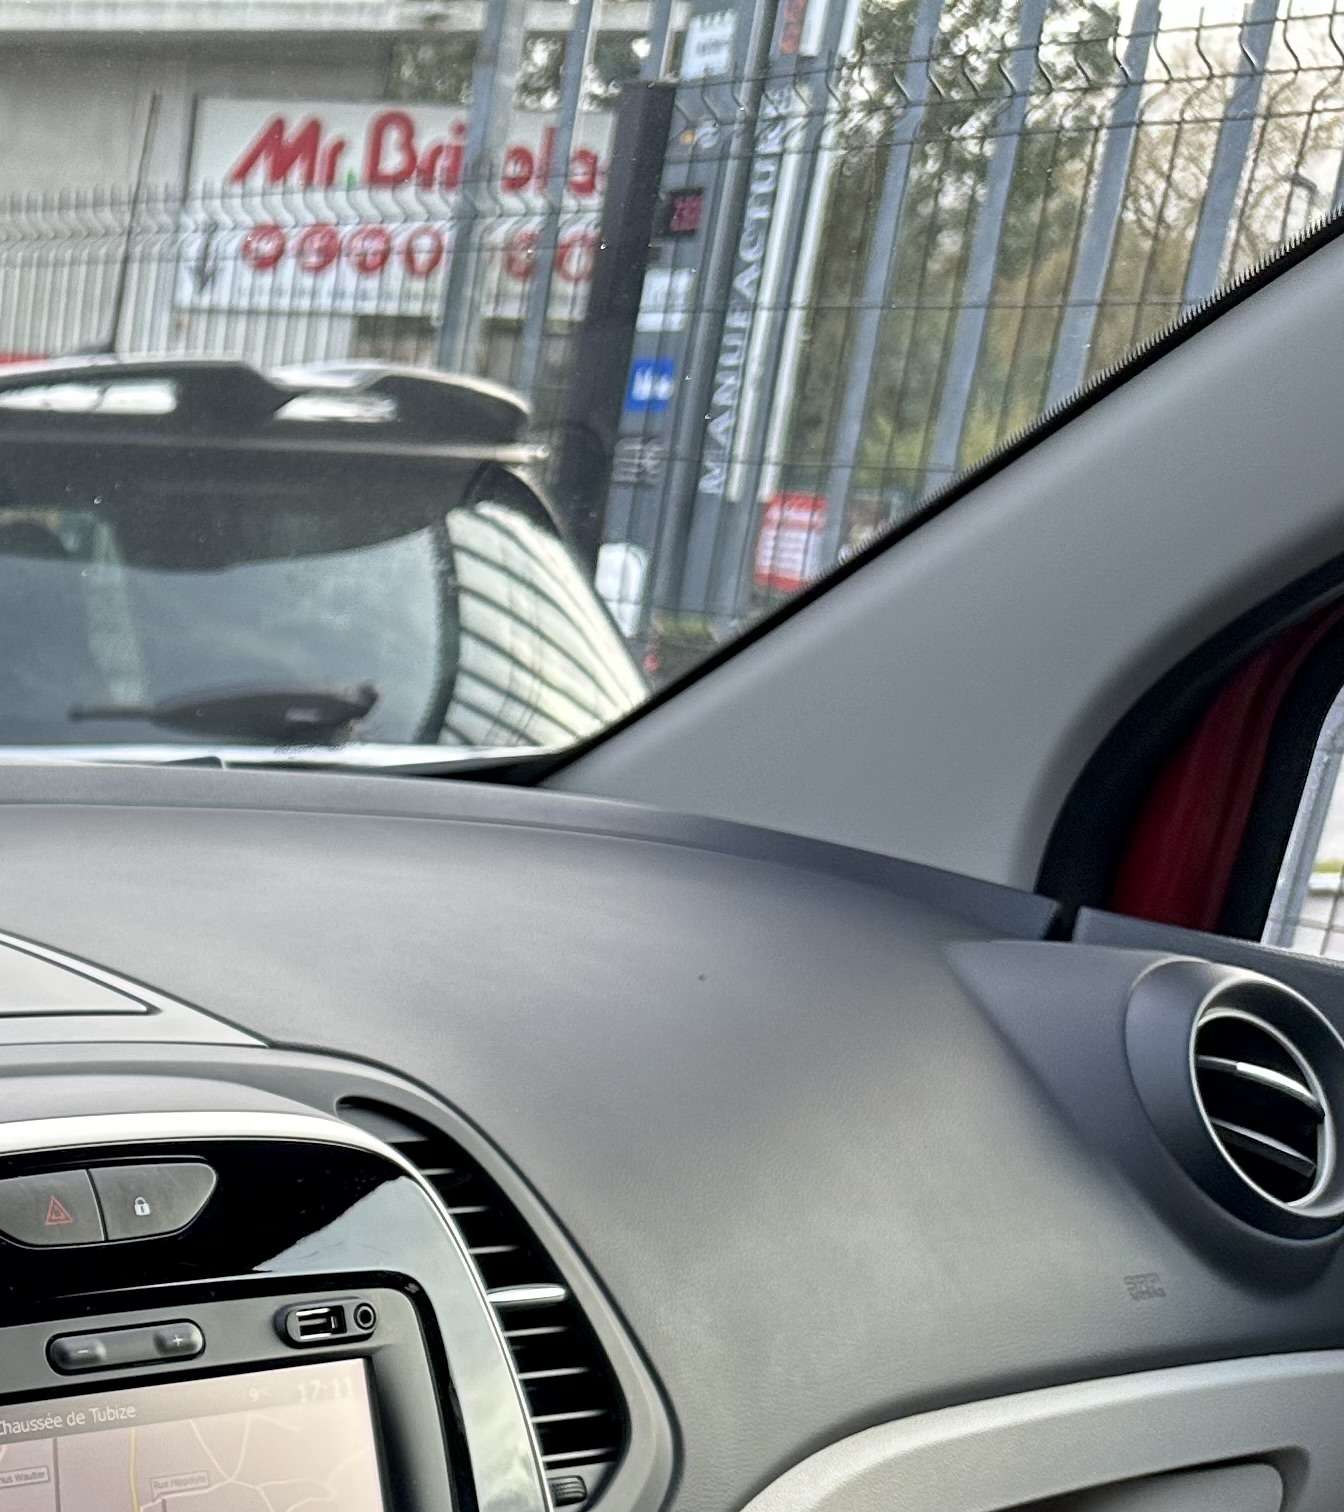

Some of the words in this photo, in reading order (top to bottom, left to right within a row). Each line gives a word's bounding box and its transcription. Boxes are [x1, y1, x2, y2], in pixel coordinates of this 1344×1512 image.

[228, 112, 346, 190] Mr
[364, 108, 602, 197] Briola
[66, 1411, 86, 1426] de
[88, 1405, 136, 1424] Tubize
